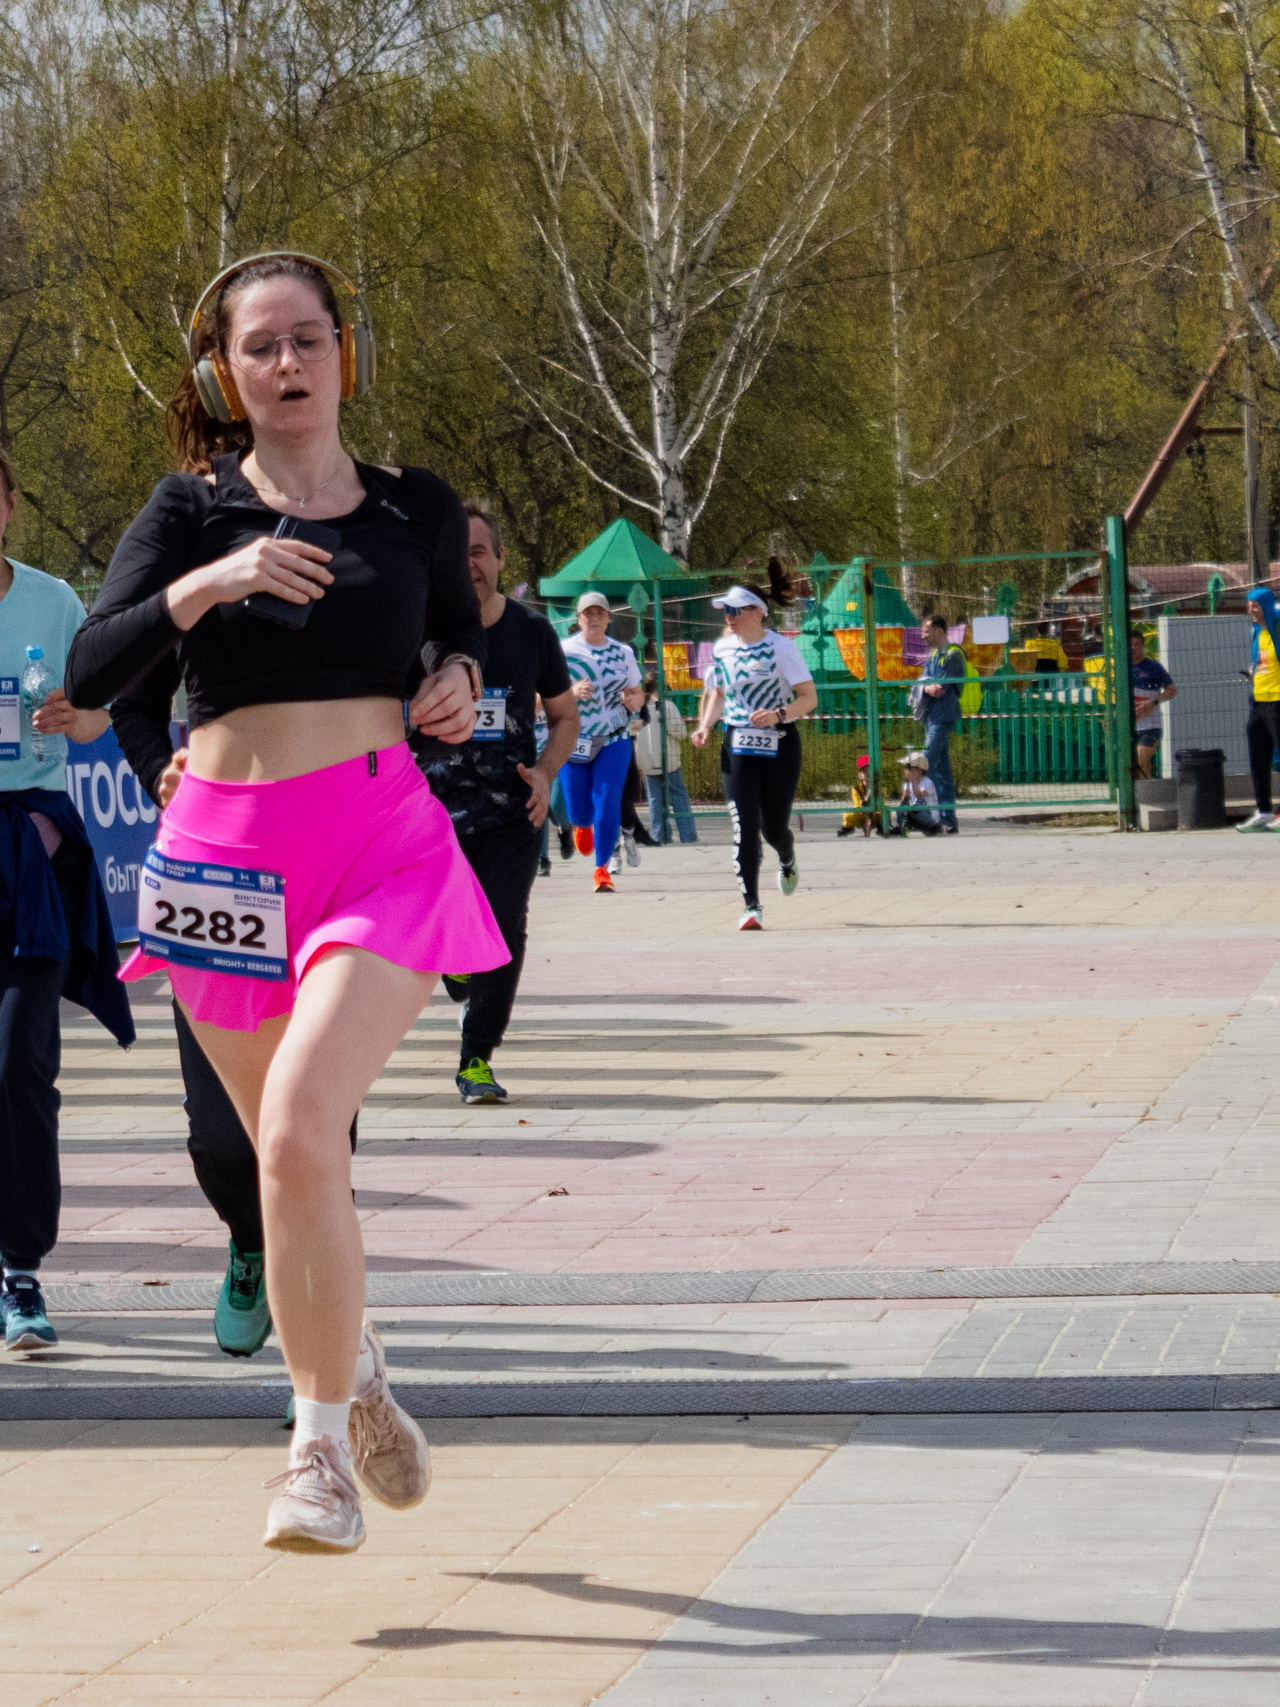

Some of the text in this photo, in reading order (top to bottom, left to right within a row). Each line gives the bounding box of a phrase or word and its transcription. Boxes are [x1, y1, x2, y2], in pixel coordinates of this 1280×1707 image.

[739, 735, 772, 748] 2232
[105, 856, 141, 895] быт
[234, 893, 281, 906] ВИКТОРИЯ
[155, 900, 267, 950] 2282
